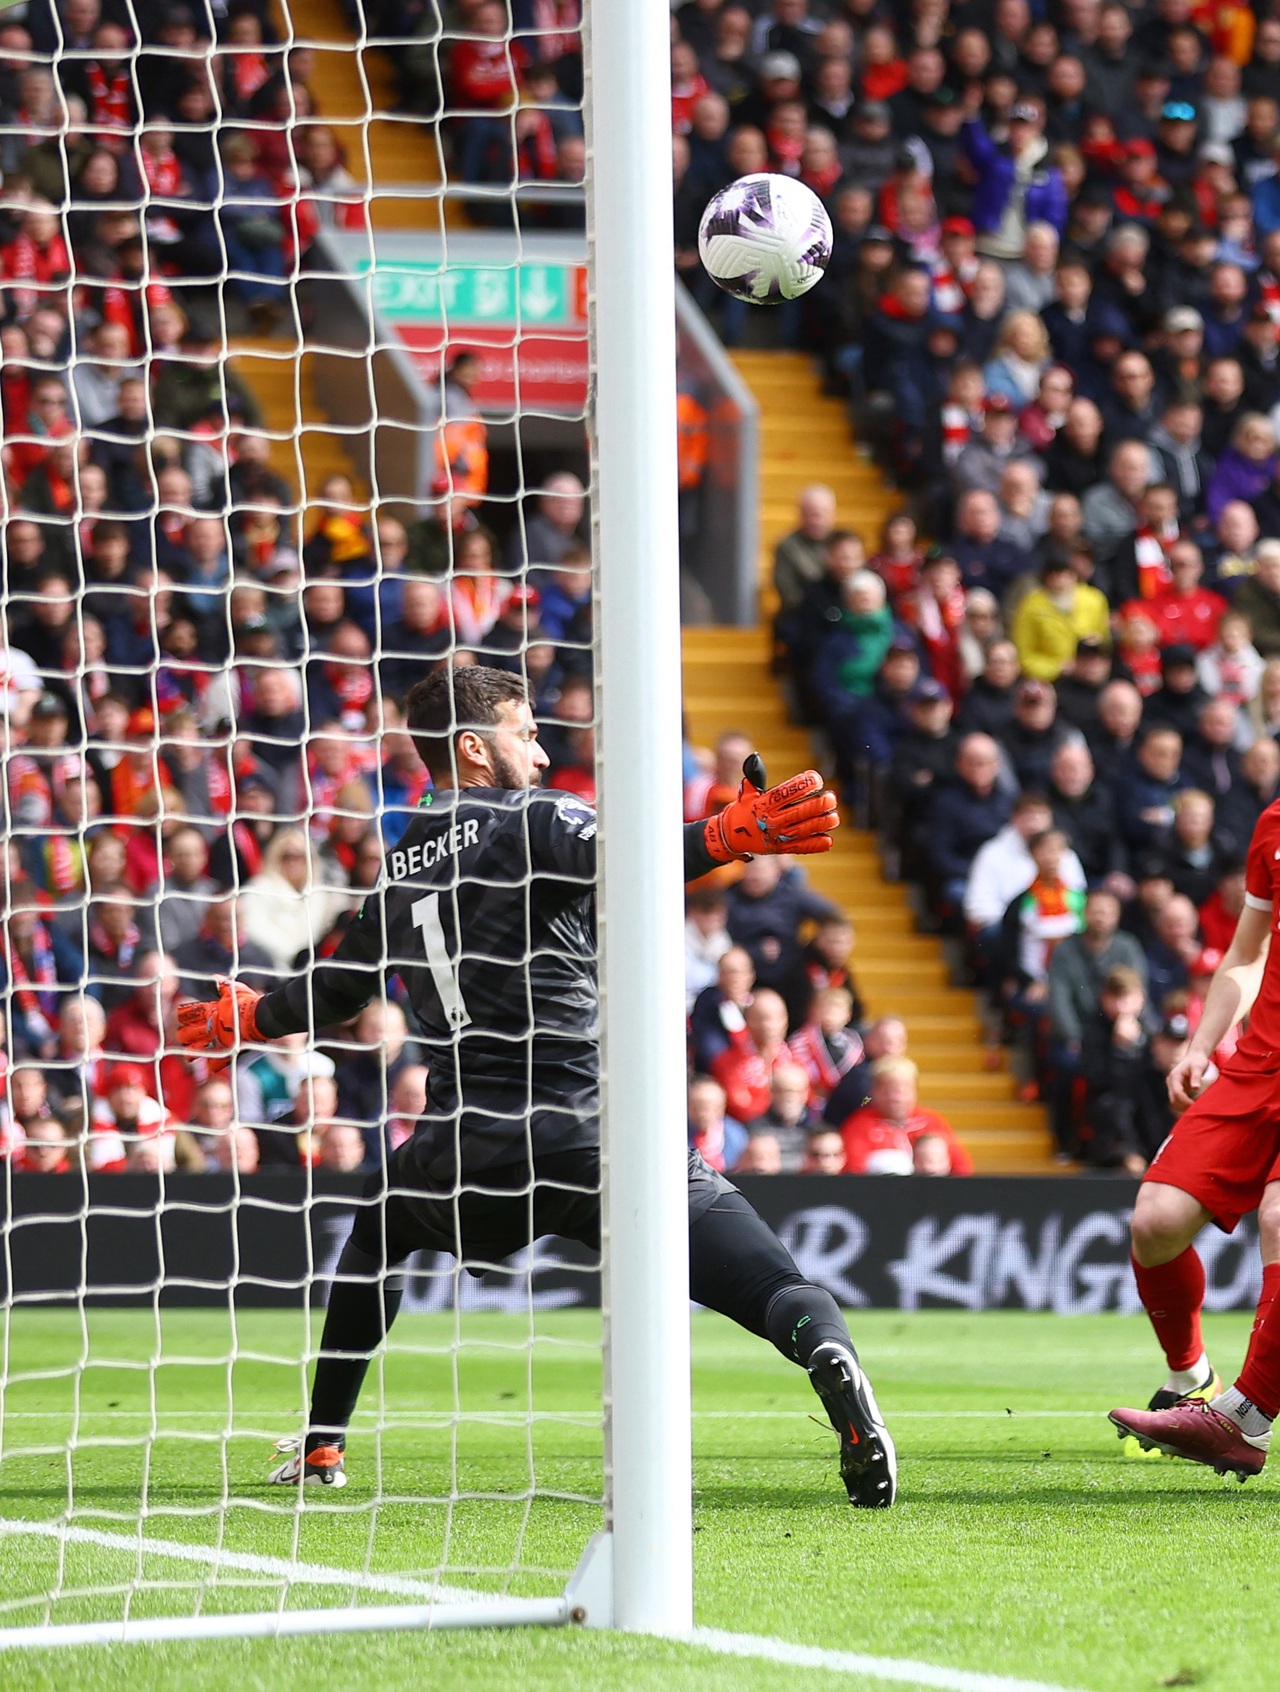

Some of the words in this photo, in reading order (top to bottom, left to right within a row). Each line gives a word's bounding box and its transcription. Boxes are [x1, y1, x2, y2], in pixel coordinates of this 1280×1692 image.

[371, 269, 463, 312] EXIT
[768, 776, 814, 806] reusch
[411, 892, 472, 1031] 1
